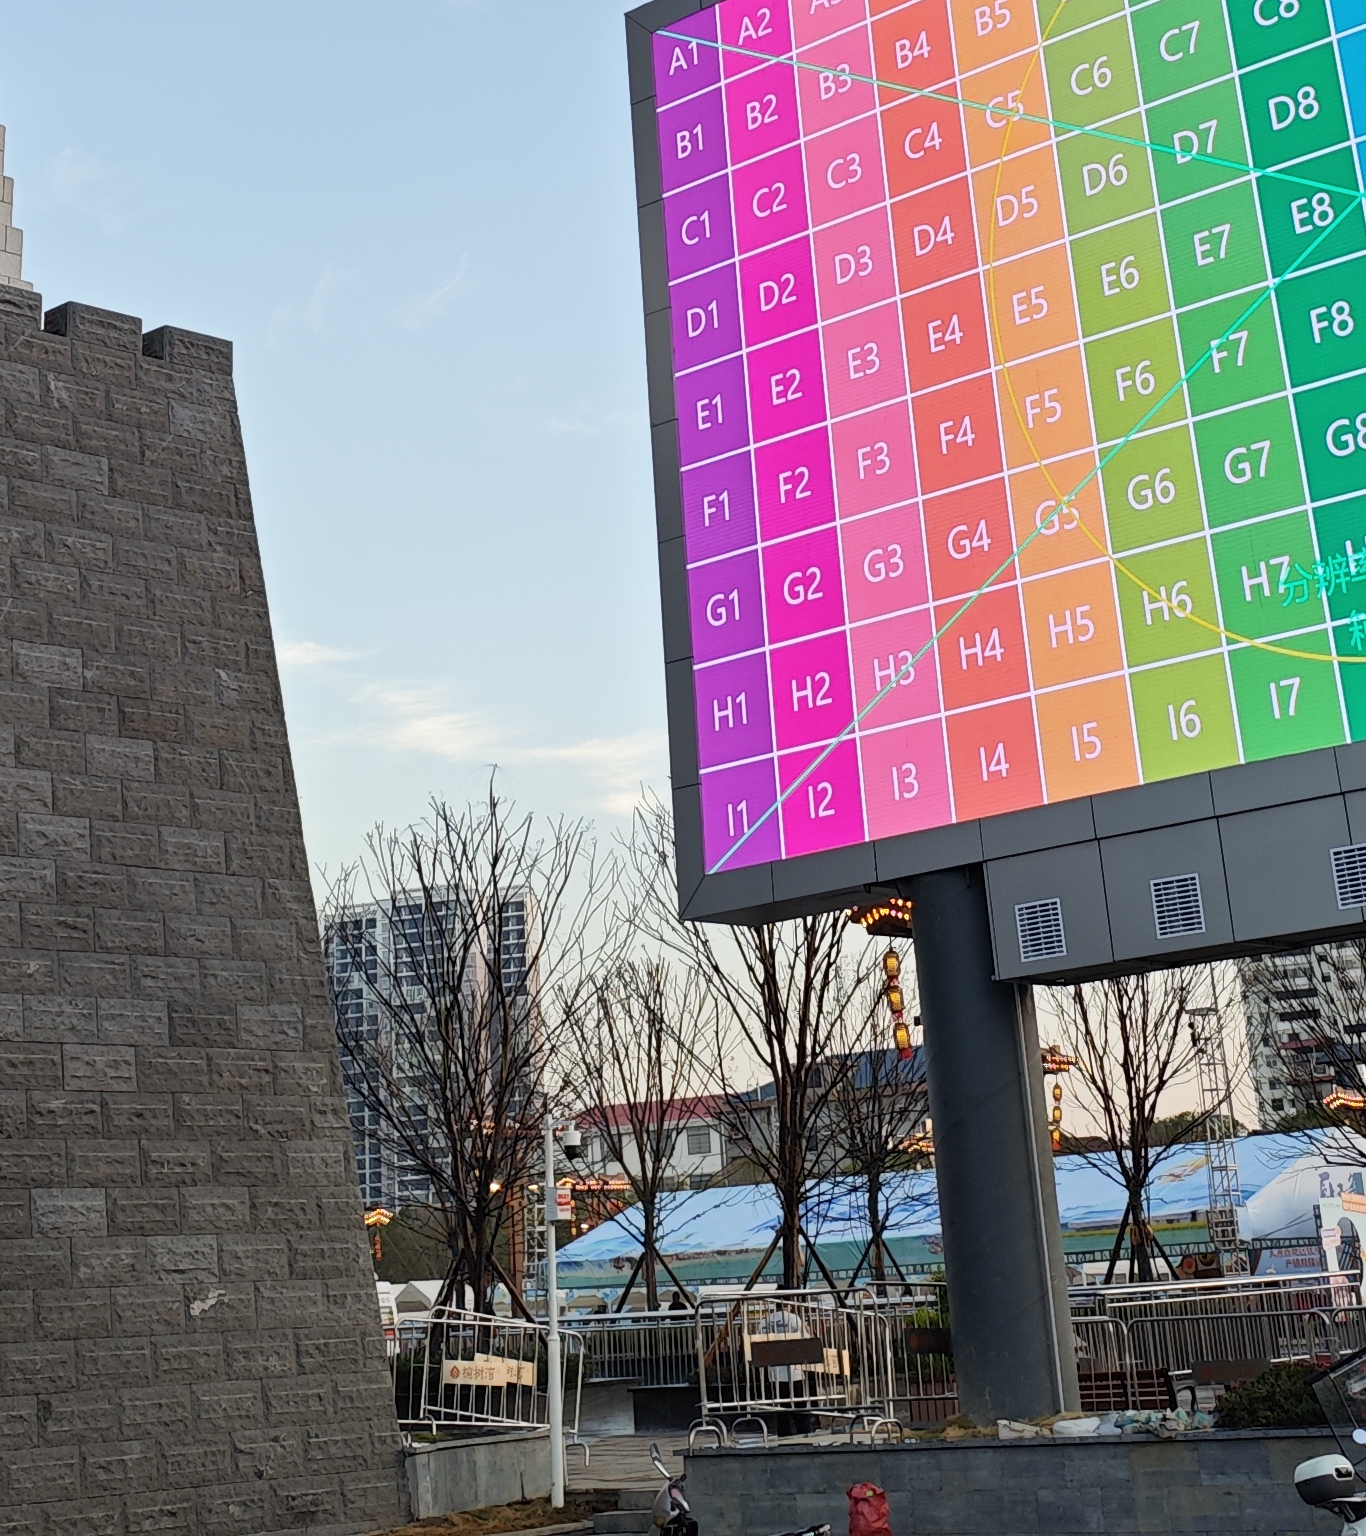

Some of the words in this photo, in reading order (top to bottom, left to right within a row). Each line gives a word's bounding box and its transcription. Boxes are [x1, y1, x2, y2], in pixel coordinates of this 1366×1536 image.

[668, 37, 698, 76] A1
[737, 6, 772, 46] A2
[675, 122, 703, 159] B1
[745, 93, 779, 131] B2
[817, 62, 852, 100] B3
[894, 29, 931, 69] B4
[680, 209, 710, 245] C1
[751, 181, 787, 218] C2
[826, 152, 862, 189] C3
[903, 120, 943, 159] C4
[984, 88, 1025, 129] C5
[1069, 54, 1112, 96] C6
[1158, 19, 1200, 62] C7
[685, 299, 718, 338] D1
[758, 272, 797, 312] D2
[833, 244, 873, 285] D3
[912, 214, 955, 256] D4
[995, 184, 1039, 227] D5
[1081, 152, 1128, 197] D6
[1171, 118, 1218, 165] D7
[1267, 84, 1320, 131] D8
[695, 393, 723, 431] E1
[769, 367, 803, 406] E2
[846, 341, 880, 380] E3
[926, 313, 964, 353] E4
[1011, 284, 1048, 326] E5
[1099, 254, 1140, 297] E6
[1192, 222, 1231, 266] E7
[1289, 191, 1334, 235] E8
[702, 489, 730, 527] F1
[777, 465, 812, 504] F2
[856, 440, 890, 480] F3
[938, 414, 975, 455] F4
[1024, 387, 1062, 429] F5
[1114, 358, 1155, 402] F6
[1209, 329, 1249, 374] F7
[1308, 299, 1354, 344] F8
[705, 587, 740, 627] G1
[782, 565, 824, 605] G2
[862, 542, 904, 583] G3
[946, 518, 992, 559] G4
[1034, 498, 1080, 536] G5
[1126, 466, 1176, 510] G6
[1223, 438, 1271, 484] G7
[712, 691, 747, 732] H1
[790, 670, 832, 712] H2
[872, 649, 915, 691] H3
[958, 626, 1004, 670] H4
[1047, 603, 1095, 648] H5
[1141, 579, 1193, 626] H6
[1240, 554, 1290, 602] H7
[726, 799, 749, 837] I1
[807, 780, 835, 819] I2
[890, 761, 919, 801] I3
[978, 741, 1010, 781] I4
[1070, 720, 1102, 762] I5
[1166, 698, 1202, 741] I6
[1268, 675, 1301, 719] I7
